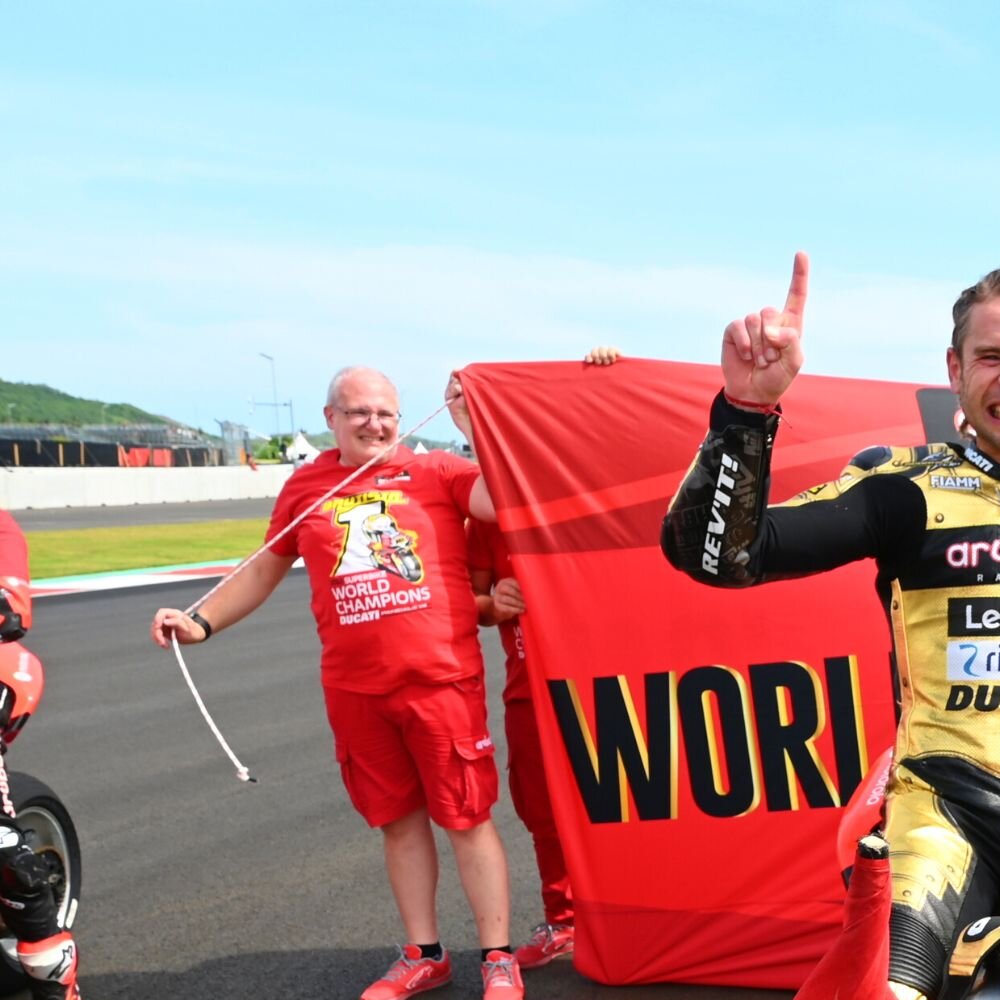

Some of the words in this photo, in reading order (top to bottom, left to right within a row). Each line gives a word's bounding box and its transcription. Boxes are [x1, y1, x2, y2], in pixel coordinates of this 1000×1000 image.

[931, 475, 981, 489] FIAMM
[702, 453, 739, 575] REV'IT!
[331, 579, 390, 600] WORLD
[335, 586, 432, 615] CHAMPIONS
[340, 609, 380, 625] DUCATI
[546, 654, 897, 824] WORL
